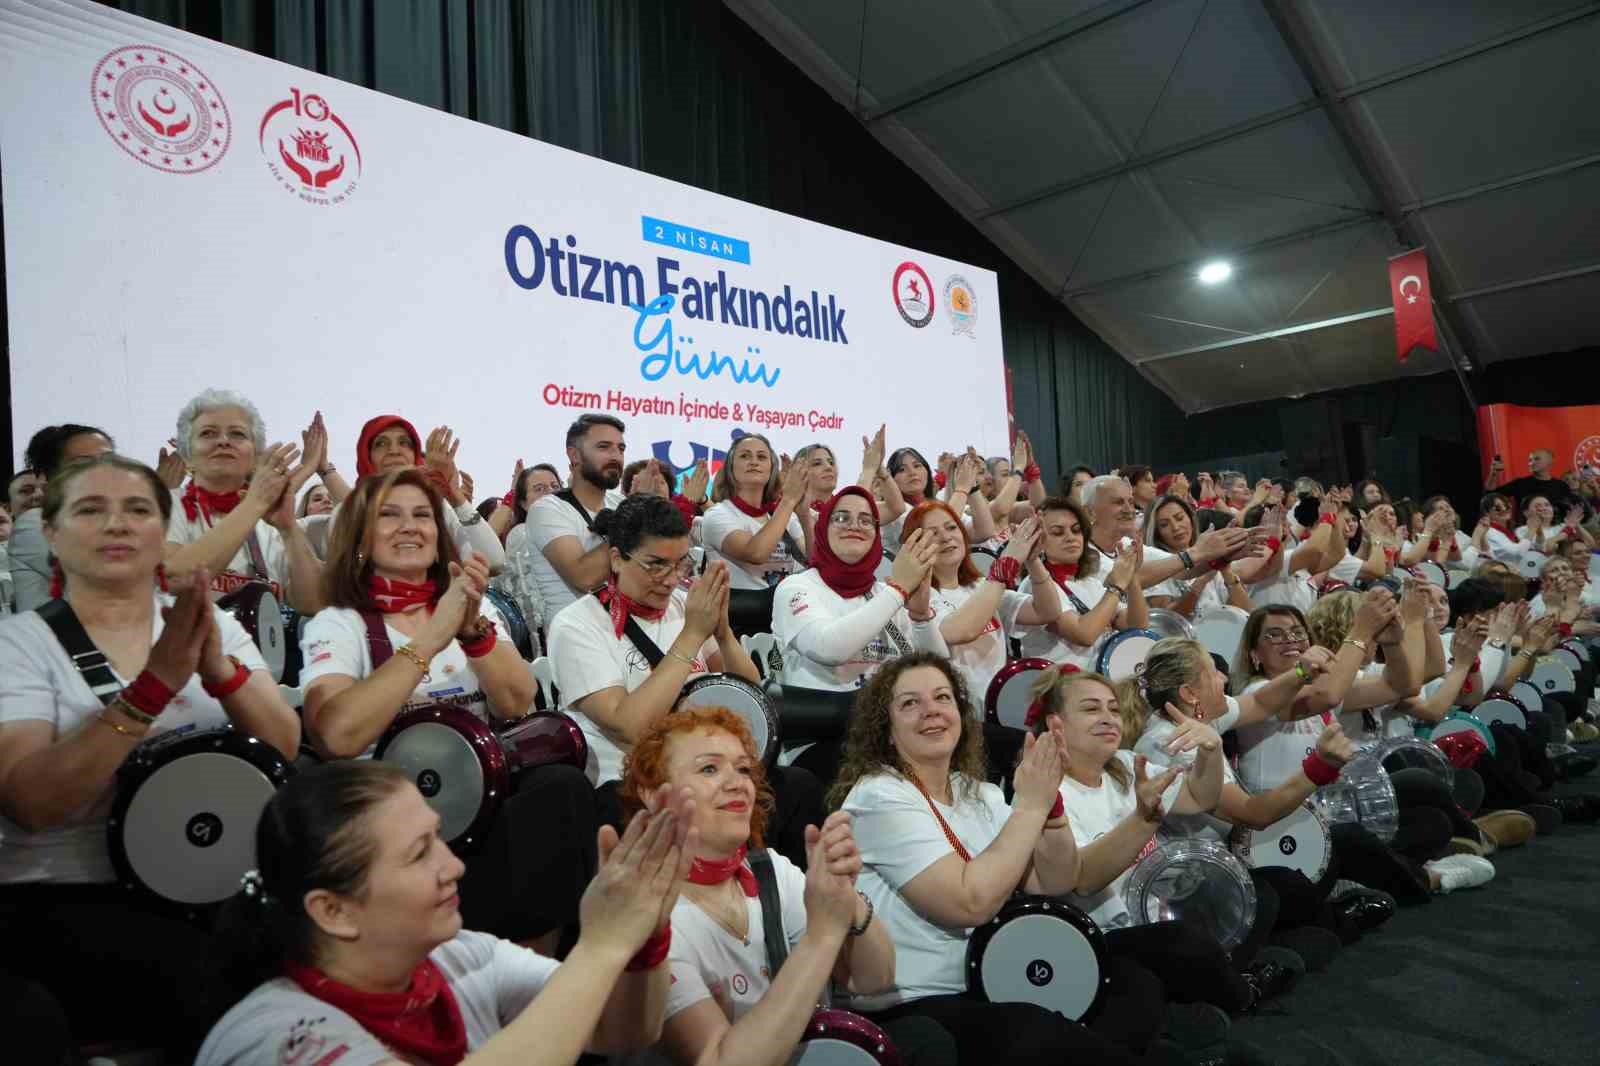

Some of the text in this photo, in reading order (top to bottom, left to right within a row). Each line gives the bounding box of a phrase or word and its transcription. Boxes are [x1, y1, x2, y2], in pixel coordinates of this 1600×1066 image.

[655, 226, 734, 256] 2 NİSAN
[505, 224, 849, 345] Otizm Farkındalık
[628, 292, 781, 389] Günü
[543, 383, 844, 432] Otizm Hayatın İçinde & Yaşayan Çadır
